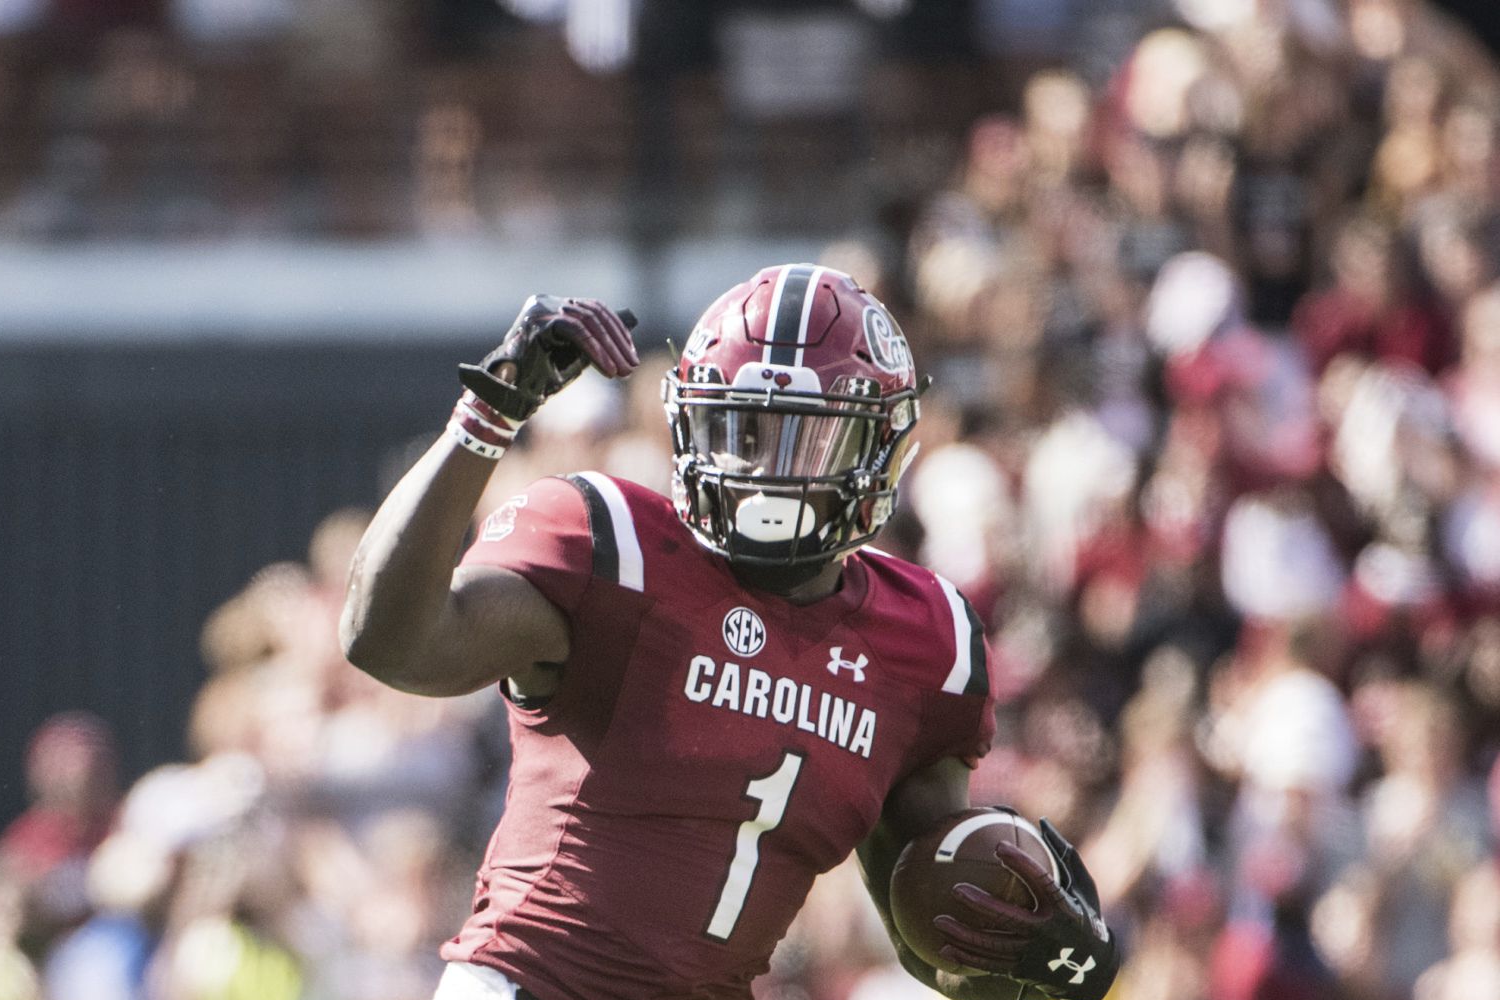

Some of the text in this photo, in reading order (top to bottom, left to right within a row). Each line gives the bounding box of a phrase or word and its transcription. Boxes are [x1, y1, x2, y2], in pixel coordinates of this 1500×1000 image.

[725, 609, 764, 655] SEC
[684, 654, 877, 759] CAROLINA
[706, 752, 803, 940] 1
